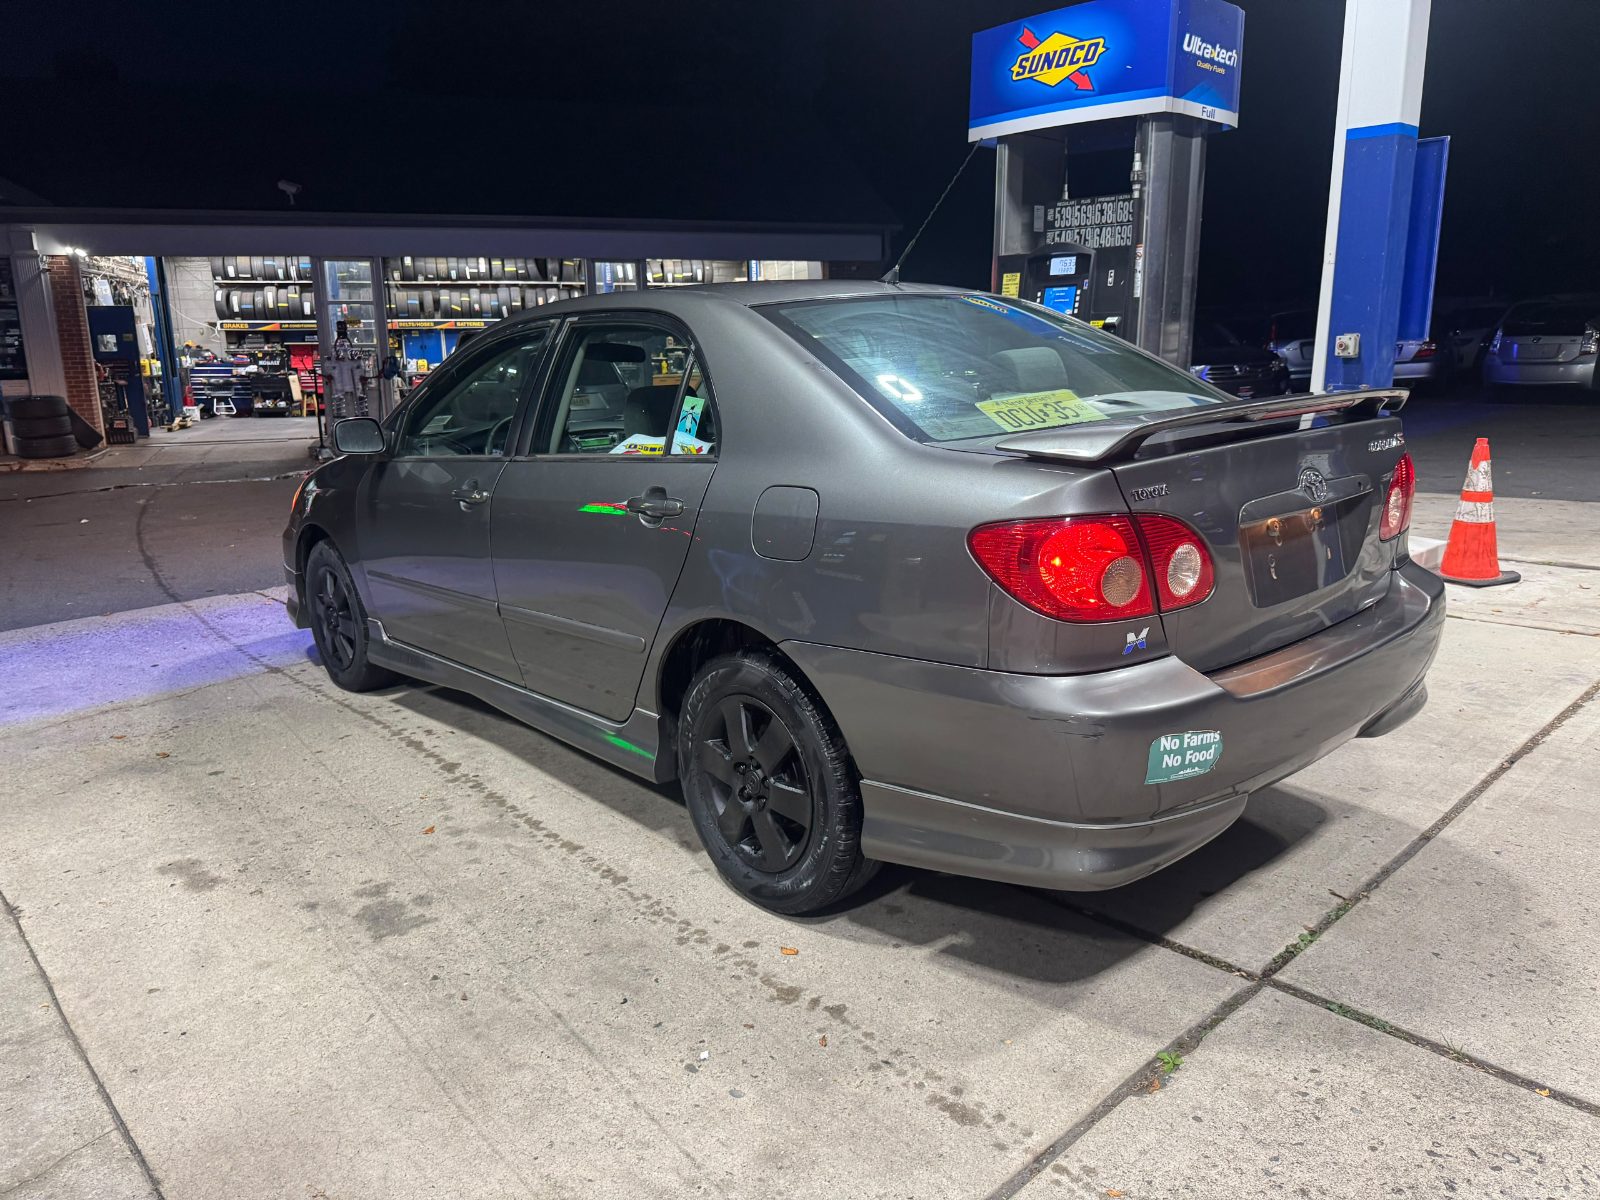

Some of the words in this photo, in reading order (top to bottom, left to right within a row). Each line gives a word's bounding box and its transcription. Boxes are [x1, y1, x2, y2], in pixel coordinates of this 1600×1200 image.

[1015, 41, 1099, 77] SUNOCO
[1196, 60, 1213, 71] Quality
[1213, 65, 1225, 74] Fuels
[1201, 106, 1216, 119] Full
[1131, 484, 1170, 501] TOYOTA
[1160, 736, 1180, 752] No
[1183, 731, 1220, 748] Farms
[1162, 754, 1181, 768] No
[1184, 744, 1215, 765] Food
